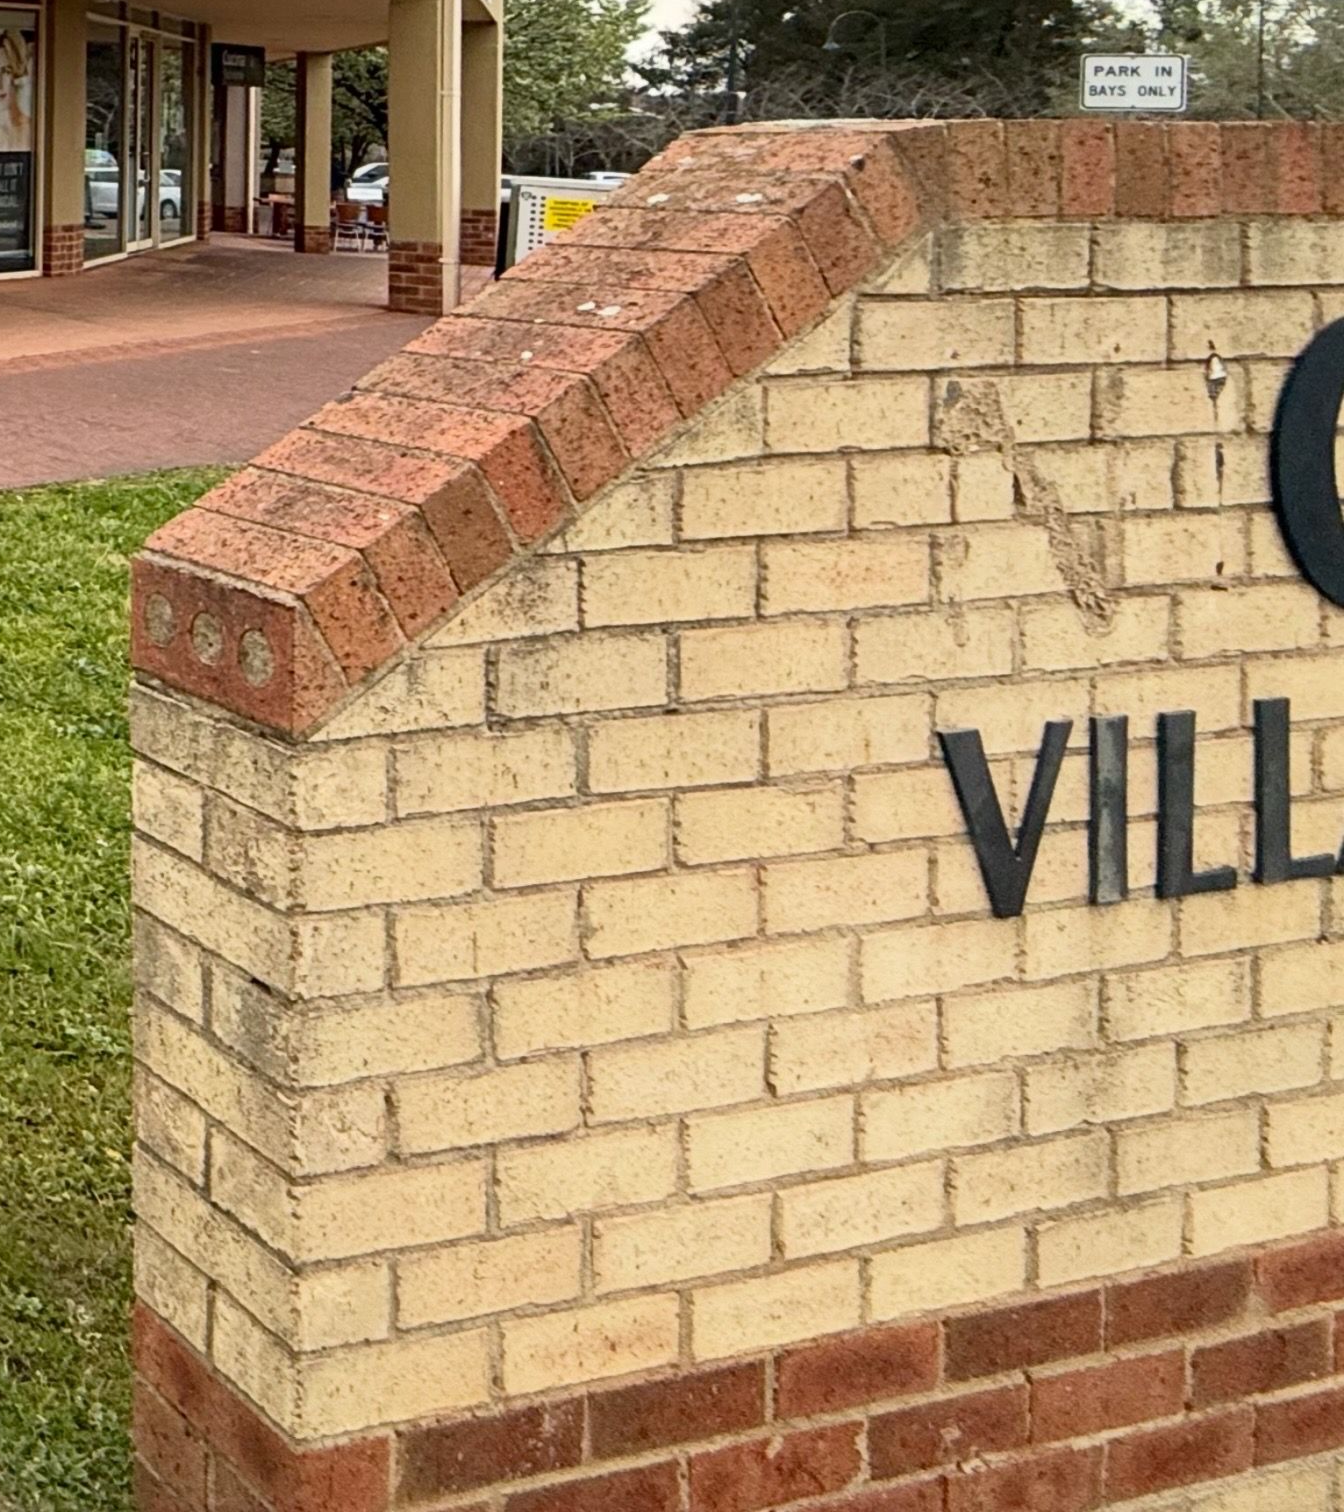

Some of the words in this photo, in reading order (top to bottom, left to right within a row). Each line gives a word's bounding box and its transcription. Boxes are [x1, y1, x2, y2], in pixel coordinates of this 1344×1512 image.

[1094, 66, 1140, 77] PARK
[1155, 66, 1172, 77] IN
[1088, 85, 1126, 96] BAYS
[1137, 85, 1177, 96] ONLY
[937, 696, 1344, 918] VILL
